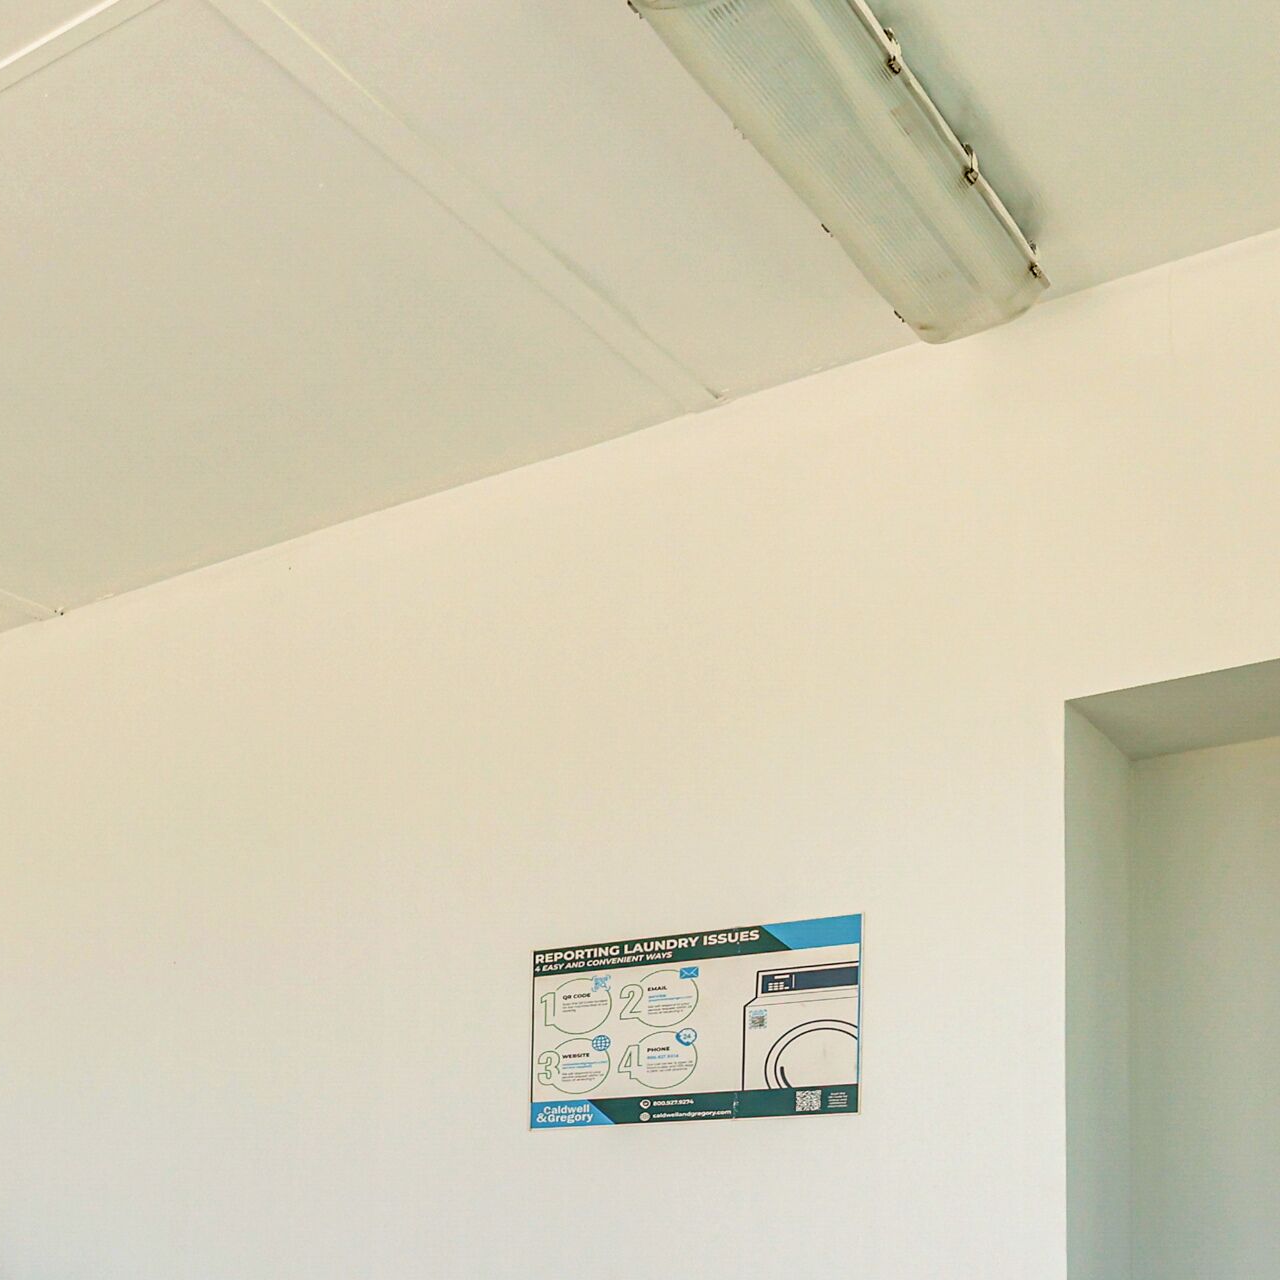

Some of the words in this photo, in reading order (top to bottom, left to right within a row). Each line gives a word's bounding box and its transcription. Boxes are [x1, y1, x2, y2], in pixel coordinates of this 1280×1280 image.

[535, 945, 620, 964] REPORTING
[623, 936, 700, 955] LAUNDRY
[703, 929, 760, 946] ISSUES
[542, 962, 564, 972] EASY
[565, 960, 585, 969] AND
[586, 954, 644, 967] CONVENIENT
[646, 951, 672, 961] WAYS
[543, 1104, 590, 1114] Caldwell
[652, 1109, 732, 1119] caldwellandgregory.com
[536, 1112, 594, 1123] &Gregory
